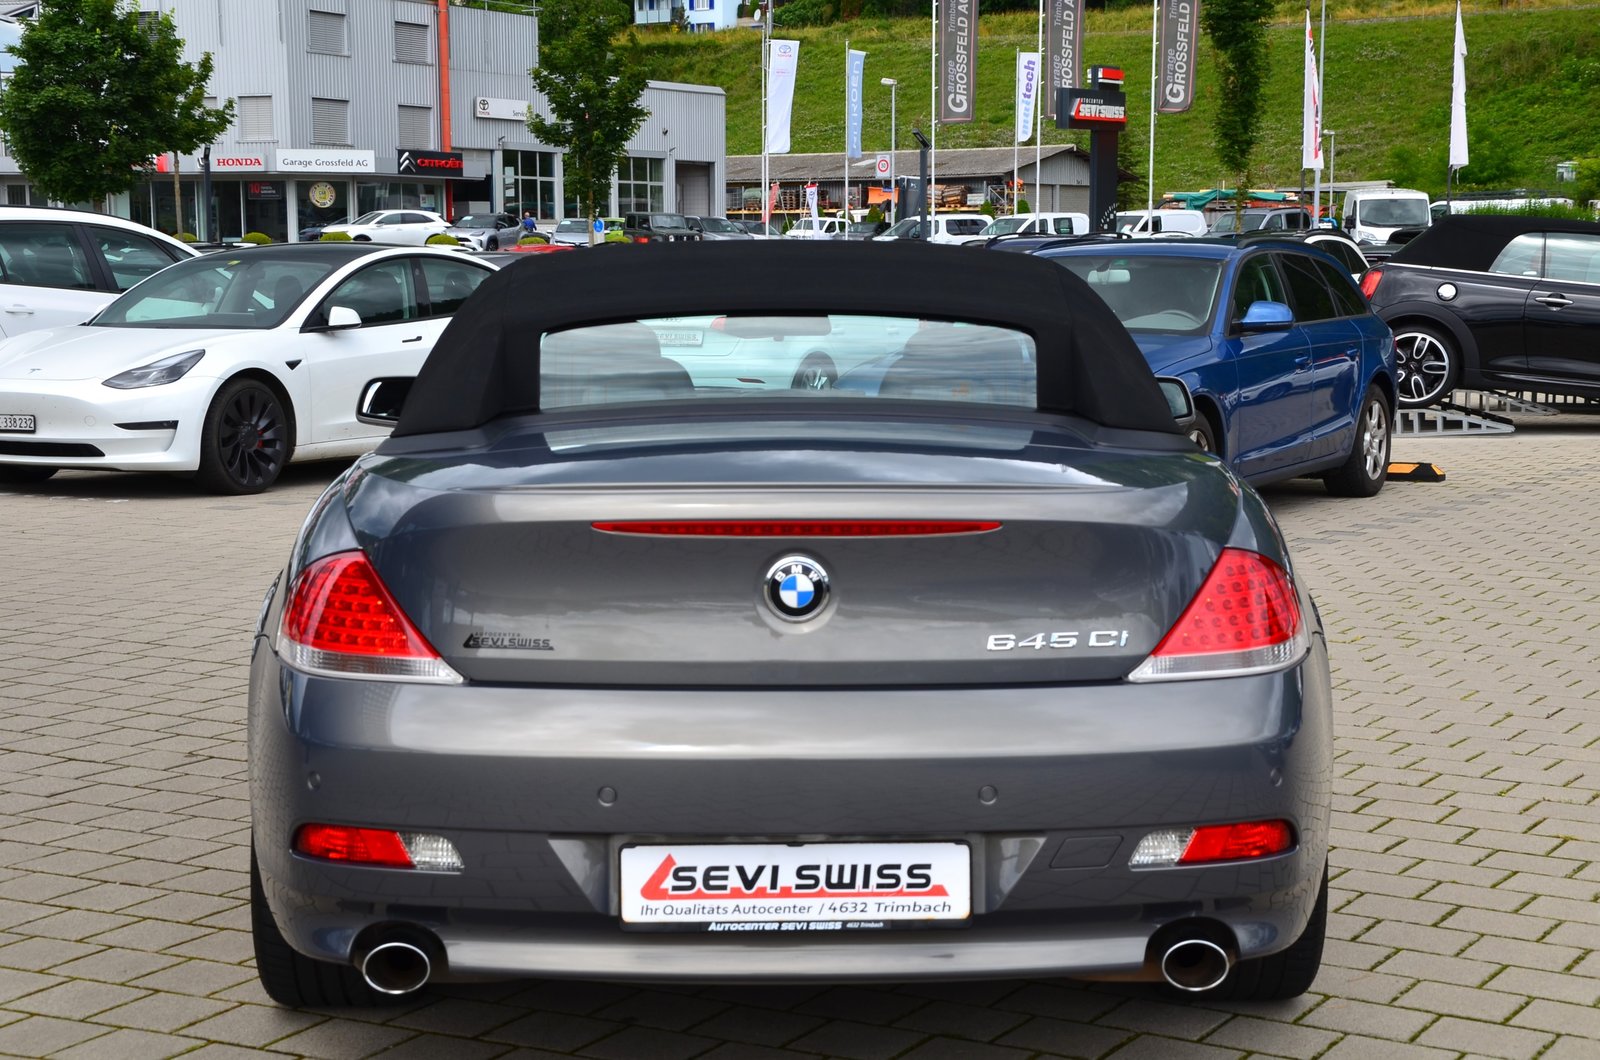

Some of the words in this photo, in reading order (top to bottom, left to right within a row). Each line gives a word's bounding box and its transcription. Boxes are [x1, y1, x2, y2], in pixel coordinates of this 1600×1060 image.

[1061, 10, 1074, 88] ROSSFELD
[1166, 2, 1190, 103] GROSSFELD
[1100, 105, 1125, 119] SWISS
[217, 158, 262, 167] HONDA
[282, 158, 312, 168] Garage
[315, 158, 354, 167] Grossfeld
[356, 159, 368, 167] AG
[774, 564, 820, 582] BMW
[471, 637, 504, 647] SEVI
[508, 638, 550, 648] SWISS
[986, 632, 1079, 651] 645
[671, 864, 780, 892] SEVI
[794, 863, 932, 890] SWISS
[640, 904, 660, 916] Ihr
[732, 903, 813, 915] Autocenter
[828, 902, 868, 913] 4632
[874, 901, 951, 913] Trimbach
[780, 922, 807, 931] SEVI
[808, 921, 842, 930] SWISS
